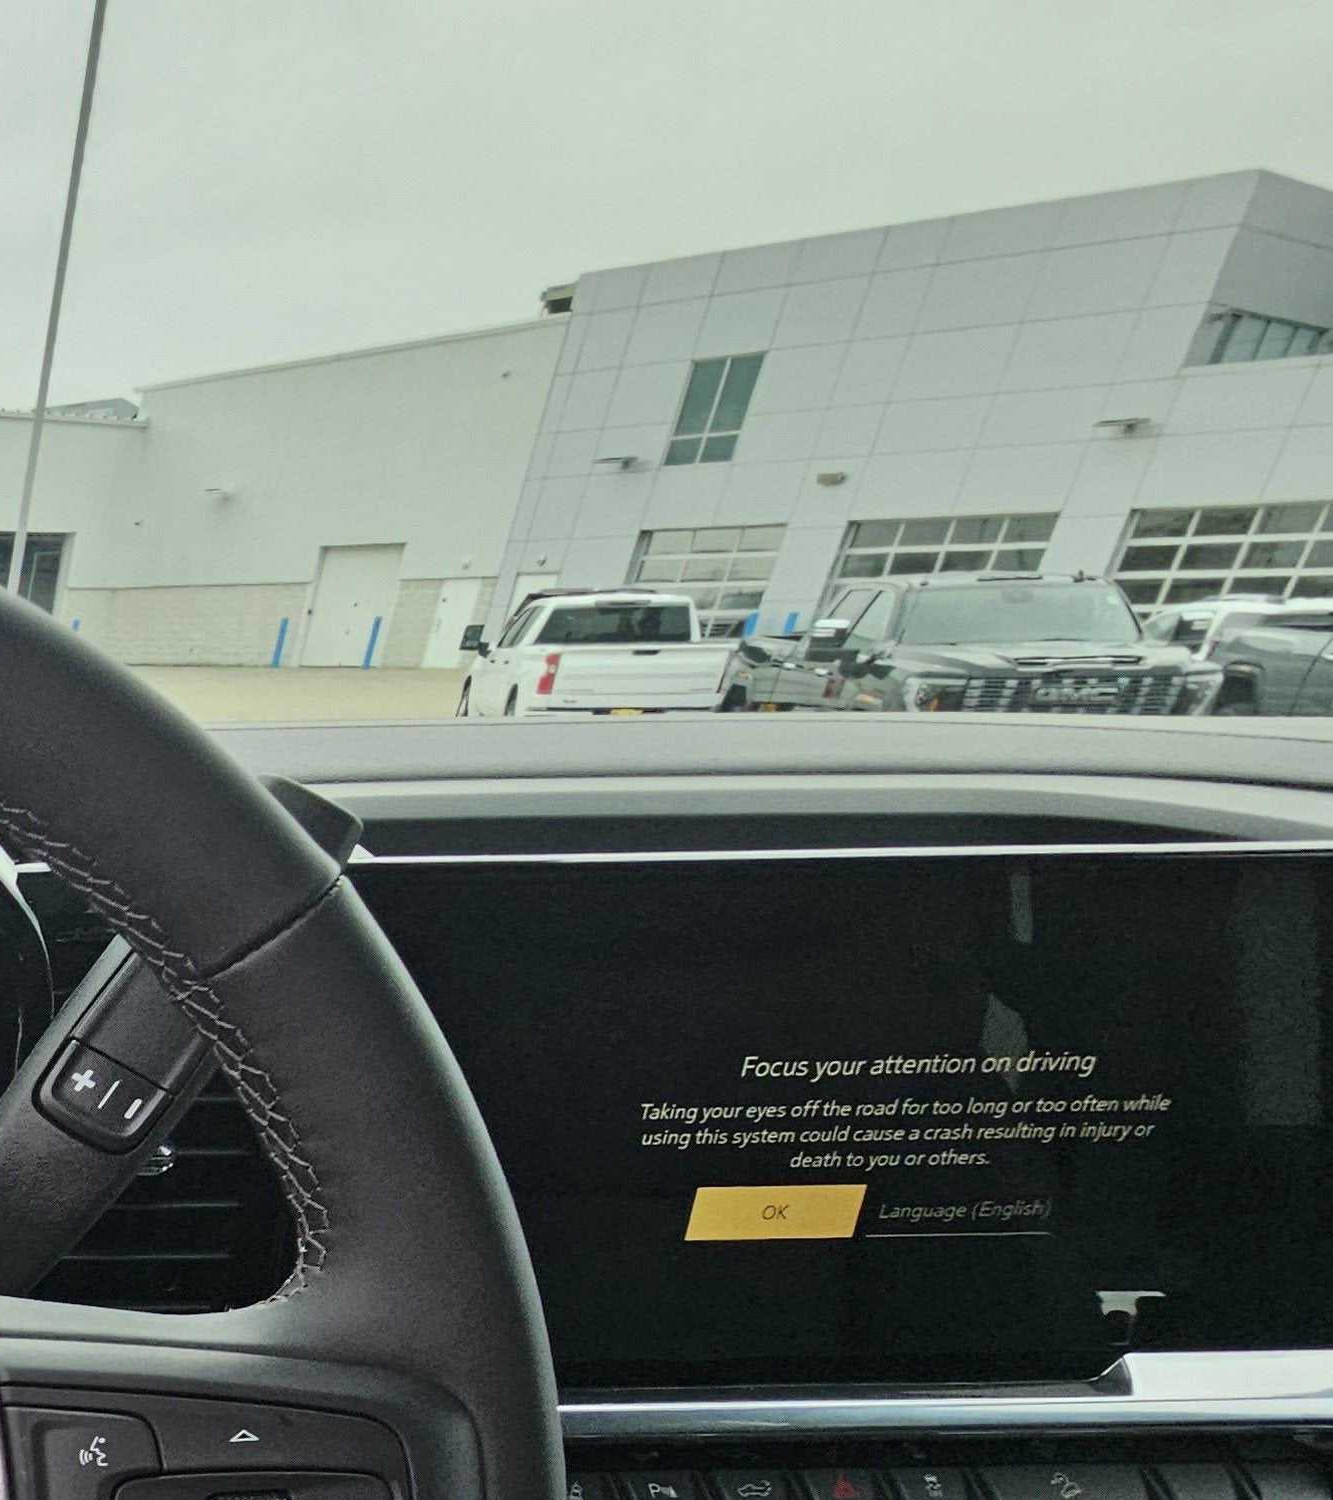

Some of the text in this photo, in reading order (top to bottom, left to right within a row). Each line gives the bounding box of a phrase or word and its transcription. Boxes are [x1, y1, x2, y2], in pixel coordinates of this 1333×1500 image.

[741, 1051, 1097, 1083] Focus your attention on driving
[641, 1094, 1172, 1124] Taking your eyes off the road for too long or too often while
[641, 1121, 1156, 1149] using this system could cause a crash resulting in injury or
[790, 1150, 991, 1171] death to you or others.
[762, 1204, 790, 1220] OK
[879, 1200, 1052, 1223] Language (English)
